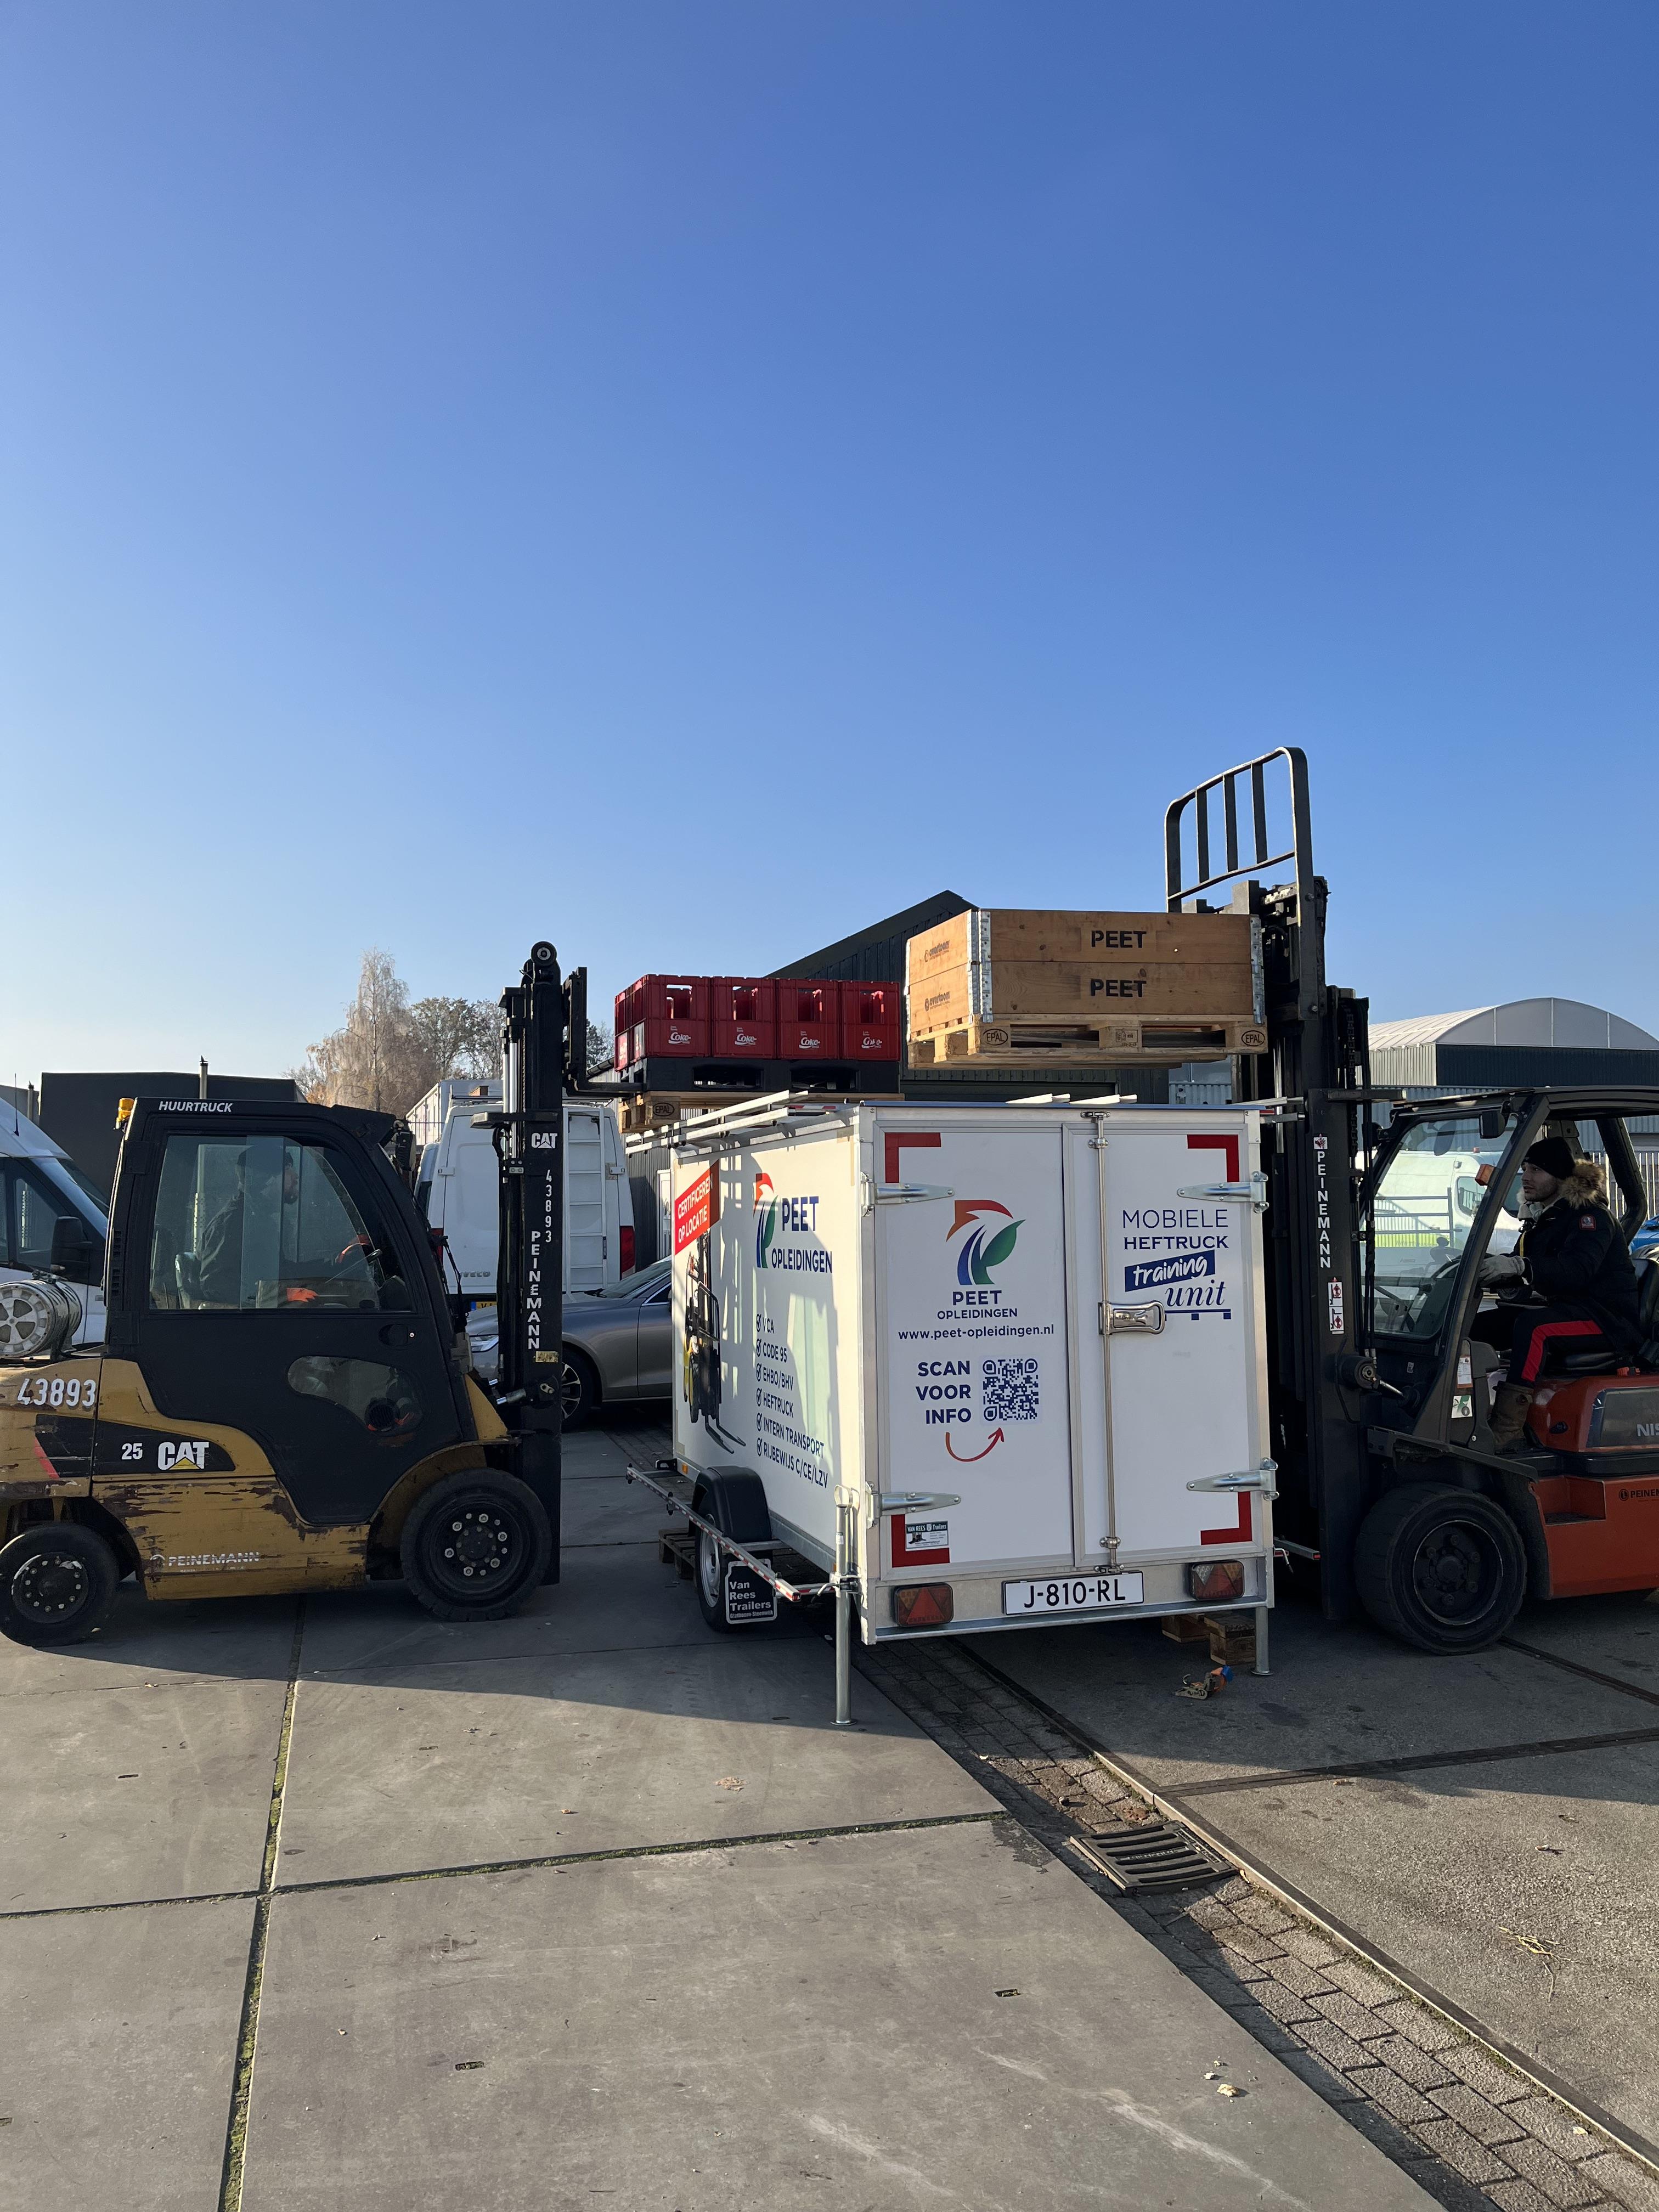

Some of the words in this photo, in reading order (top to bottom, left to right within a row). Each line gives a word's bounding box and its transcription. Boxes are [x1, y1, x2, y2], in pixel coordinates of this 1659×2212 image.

[1091, 930, 1147, 948] PEET
[1090, 978, 1147, 997] PEET
[986, 1031, 1005, 1042] EPAL
[1245, 1034, 1262, 1043] EPAL
[159, 1101, 234, 1113] HUURTRUCK
[655, 1105, 672, 1114] EPAL
[531, 1132, 558, 1149] CAT
[678, 1172, 713, 1220] CERTIFICEREN
[782, 1195, 819, 1232] PEET
[1317, 1150, 1331, 1268] PEINEMANN
[678, 1225, 685, 1244] OP
[686, 1204, 708, 1238] LOCATIE
[1122, 1209, 1228, 1229] MOBIELE
[1124, 1235, 1229, 1250] HEFTRUCK
[771, 1248, 832, 1273] OPLEIDINGEN
[1133, 1256, 1208, 1286] training
[527, 1231, 542, 1350] PEINEMANN
[952, 1290, 1002, 1306] PEET
[1165, 1279, 1227, 1307] unit
[937, 1308, 1018, 1319] OPLEIDINGEN
[763, 1317, 775, 1334] VCA
[898, 1324, 1054, 1340] www.peet-opleidingen.nl
[763, 1342, 778, 1361] CODE
[780, 1346, 787, 1363] 95
[917, 1360, 970, 1377] SCAN
[763, 1367, 794, 1391] EHBO/BHV
[17, 1378, 96, 1407] 43893
[915, 1384, 972, 1401] VOOR
[763, 1391, 794, 1418] HEFTRUCK
[926, 1408, 972, 1425] INFO
[763, 1417, 785, 1440] INTERN
[786, 1426, 825, 1459] TRANSPORT
[121, 1443, 143, 1460] 25
[157, 1442, 210, 1470] CAT
[764, 1442, 794, 1471] RIJBEWIJS
[795, 1458, 828, 1489] C/CE/LZV
[168, 1552, 259, 1567] PEINEMANN
[729, 1581, 750, 1590] Van
[1024, 1578, 1126, 1609] J-810-RL
[729, 1592, 756, 1600] Rees
[730, 1601, 771, 1611] Trailers
